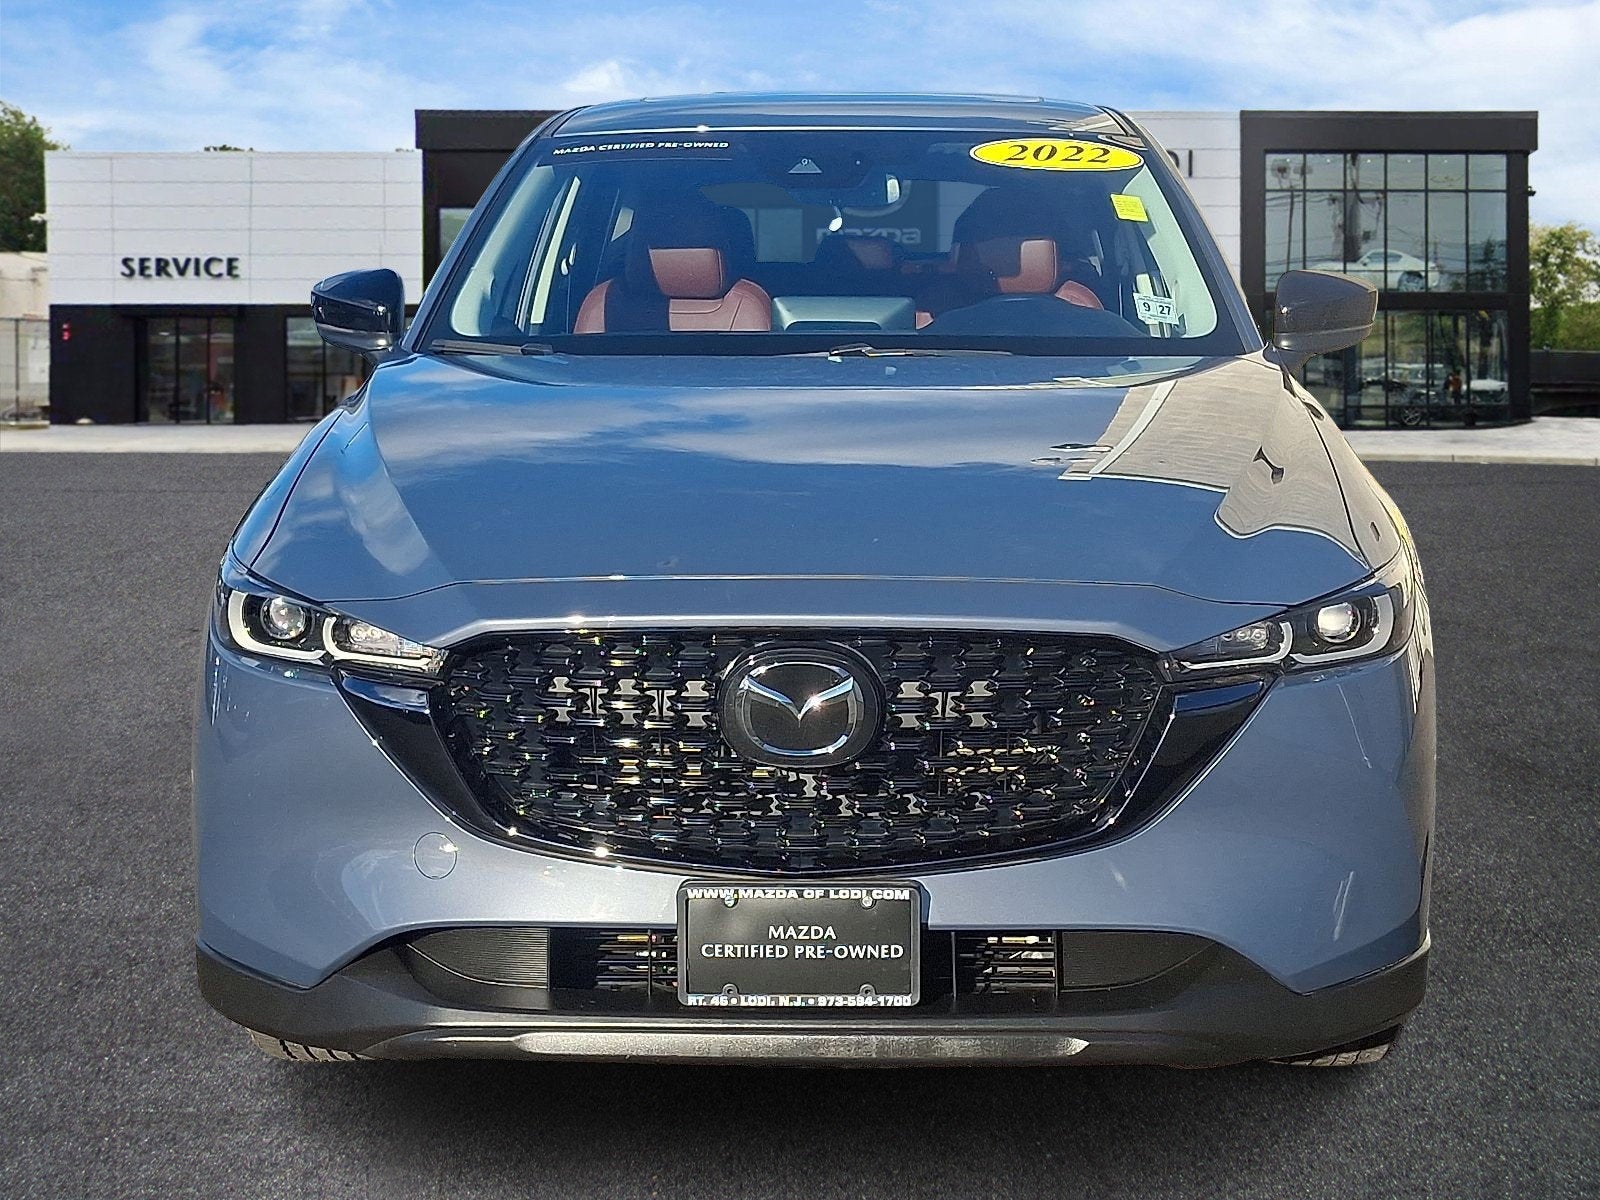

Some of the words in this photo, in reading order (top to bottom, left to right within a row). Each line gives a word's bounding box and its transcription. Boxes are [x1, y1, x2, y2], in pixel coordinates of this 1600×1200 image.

[552, 145, 596, 156] MAZDA
[598, 141, 655, 152] CERTIFIED
[657, 141, 730, 149] PRE-OWNED
[1004, 144, 1111, 164] 2022
[120, 256, 241, 278] SERVICE
[1142, 301, 1151, 312] 9
[1158, 304, 1171, 316] 27
[803, 889, 825, 899] OF
[768, 925, 837, 940] MAZDA
[700, 943, 789, 959] CERTIFIED
[794, 944, 904, 960] PRE-OWNED
[710, 996, 729, 1006] 46
